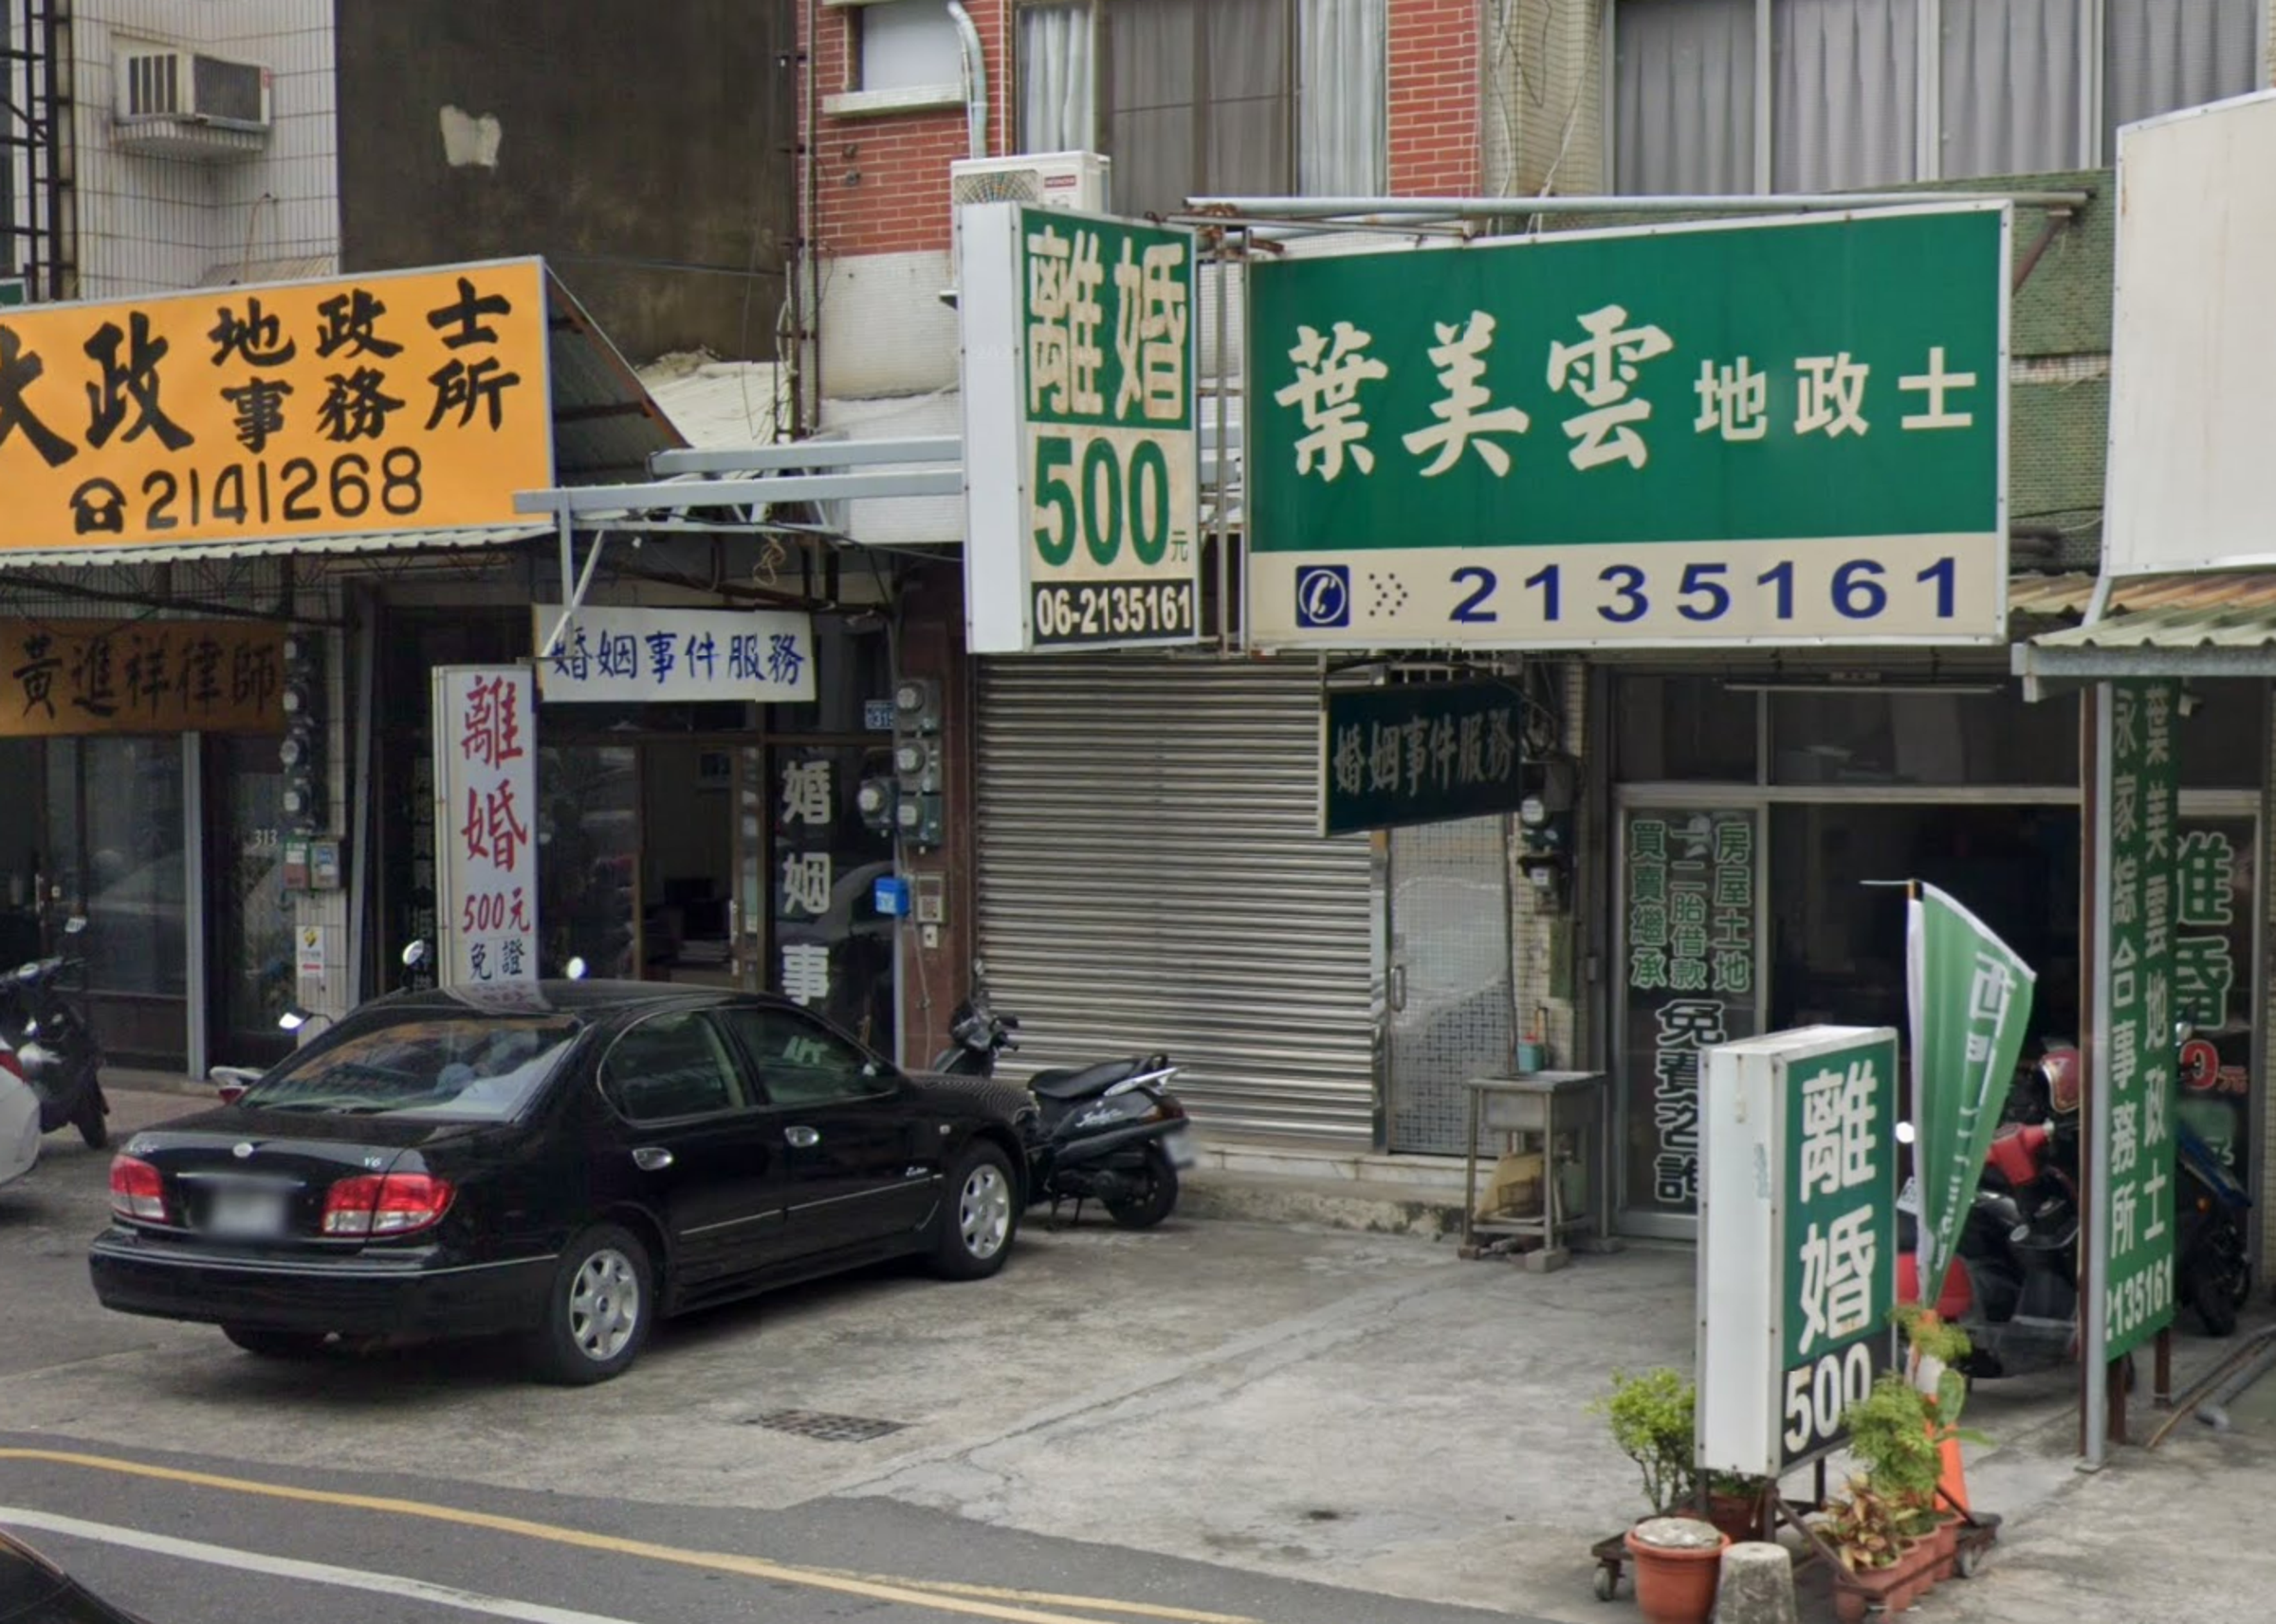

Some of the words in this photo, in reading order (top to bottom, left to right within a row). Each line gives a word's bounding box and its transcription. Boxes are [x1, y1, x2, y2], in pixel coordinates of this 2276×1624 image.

[208, 277, 512, 368] 地政士
[1027, 224, 1186, 420] 離婚
[219, 356, 521, 454] 事務所
[1275, 304, 1674, 483] 葉美雲
[1692, 346, 1978, 442] 地政士
[141, 446, 423, 532] 2141268
[1036, 584, 1193, 637] 06-2135161
[1448, 557, 1958, 623] 2135161
[550, 626, 805, 685] 婚姻事件服務
[460, 674, 527, 873] 離婚
[1332, 708, 1516, 797] 婚姻事件服務
[462, 885, 531, 933] 500元
[1713, 821, 1752, 992] 房屋土地
[1799, 1059, 1879, 1356] 離婚
[1784, 1341, 1873, 1453] 500
